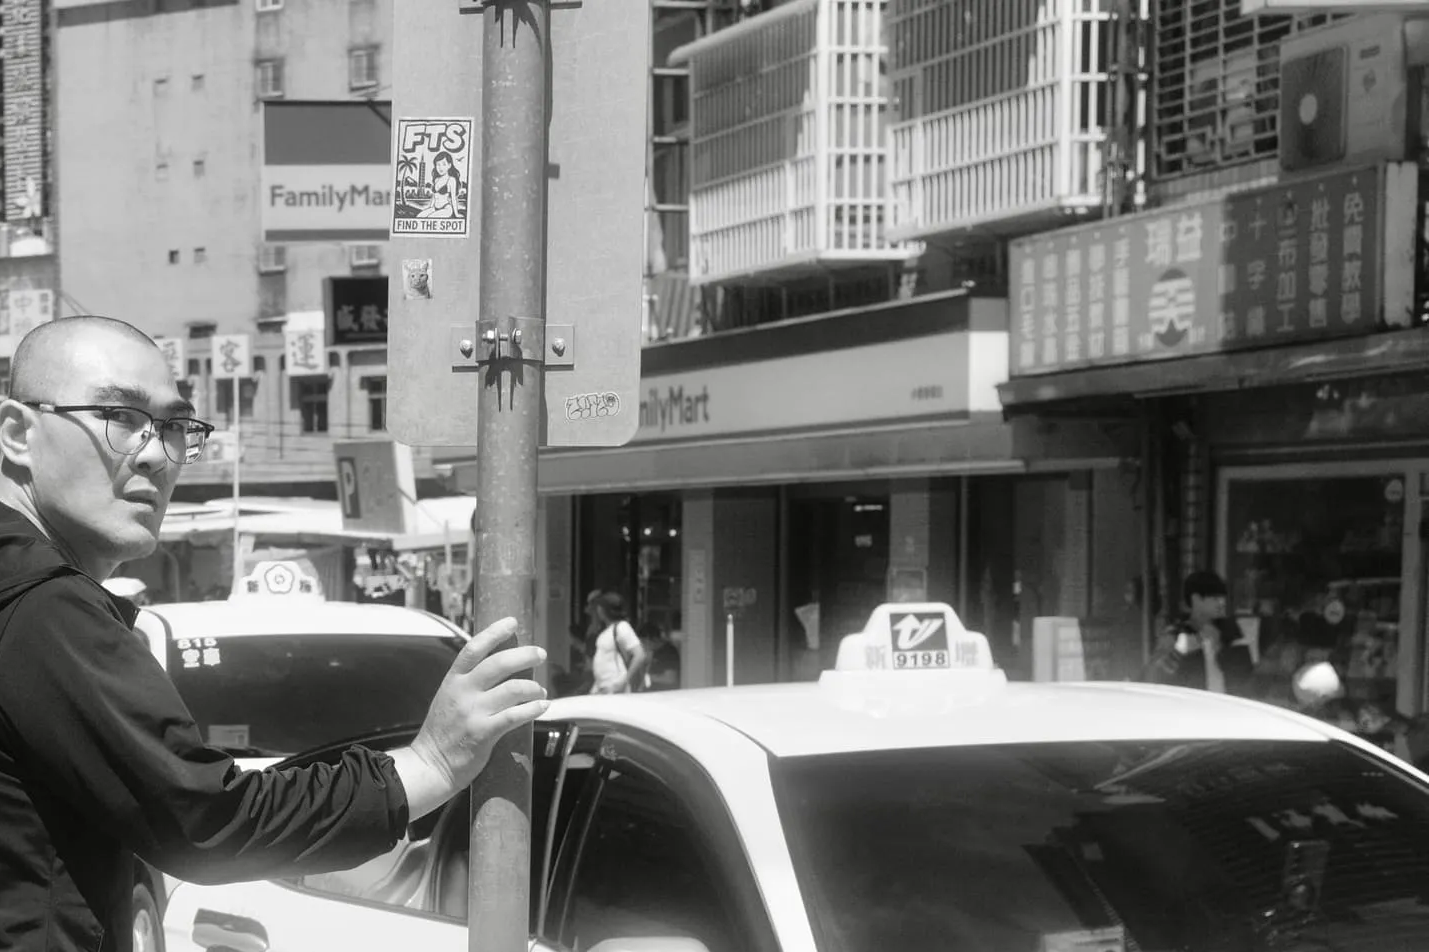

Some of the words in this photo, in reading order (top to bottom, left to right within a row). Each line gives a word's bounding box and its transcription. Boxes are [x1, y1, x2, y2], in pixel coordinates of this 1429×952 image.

[402, 123, 466, 153] FTS
[270, 184, 391, 212] FamilyMar
[397, 220, 418, 231] FIND
[420, 220, 438, 231] THE
[439, 220, 464, 231] SPOT
[639, 384, 710, 432] milyMart
[896, 652, 946, 666] 9198
